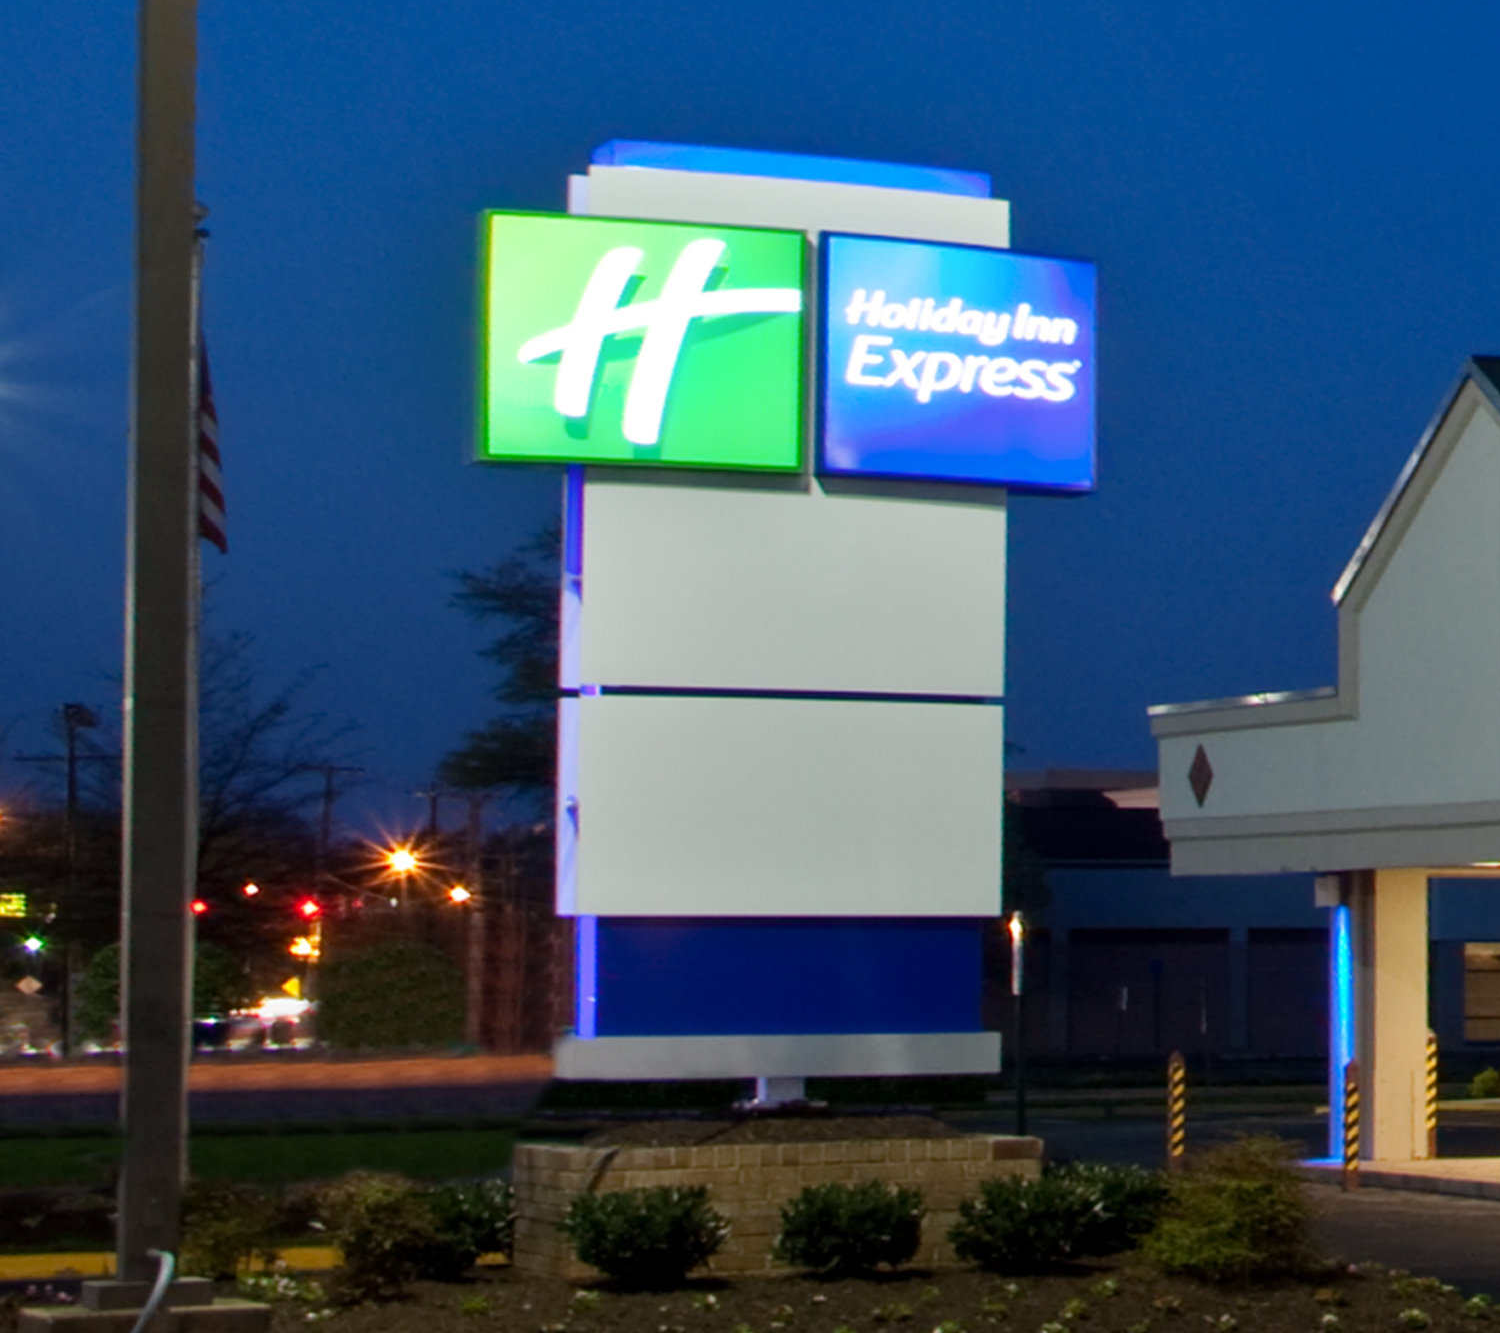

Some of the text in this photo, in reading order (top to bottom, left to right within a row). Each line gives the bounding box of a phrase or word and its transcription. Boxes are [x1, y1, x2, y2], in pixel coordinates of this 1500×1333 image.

[845, 288, 1078, 347] Holiday Inn
[846, 334, 1079, 403] Express
